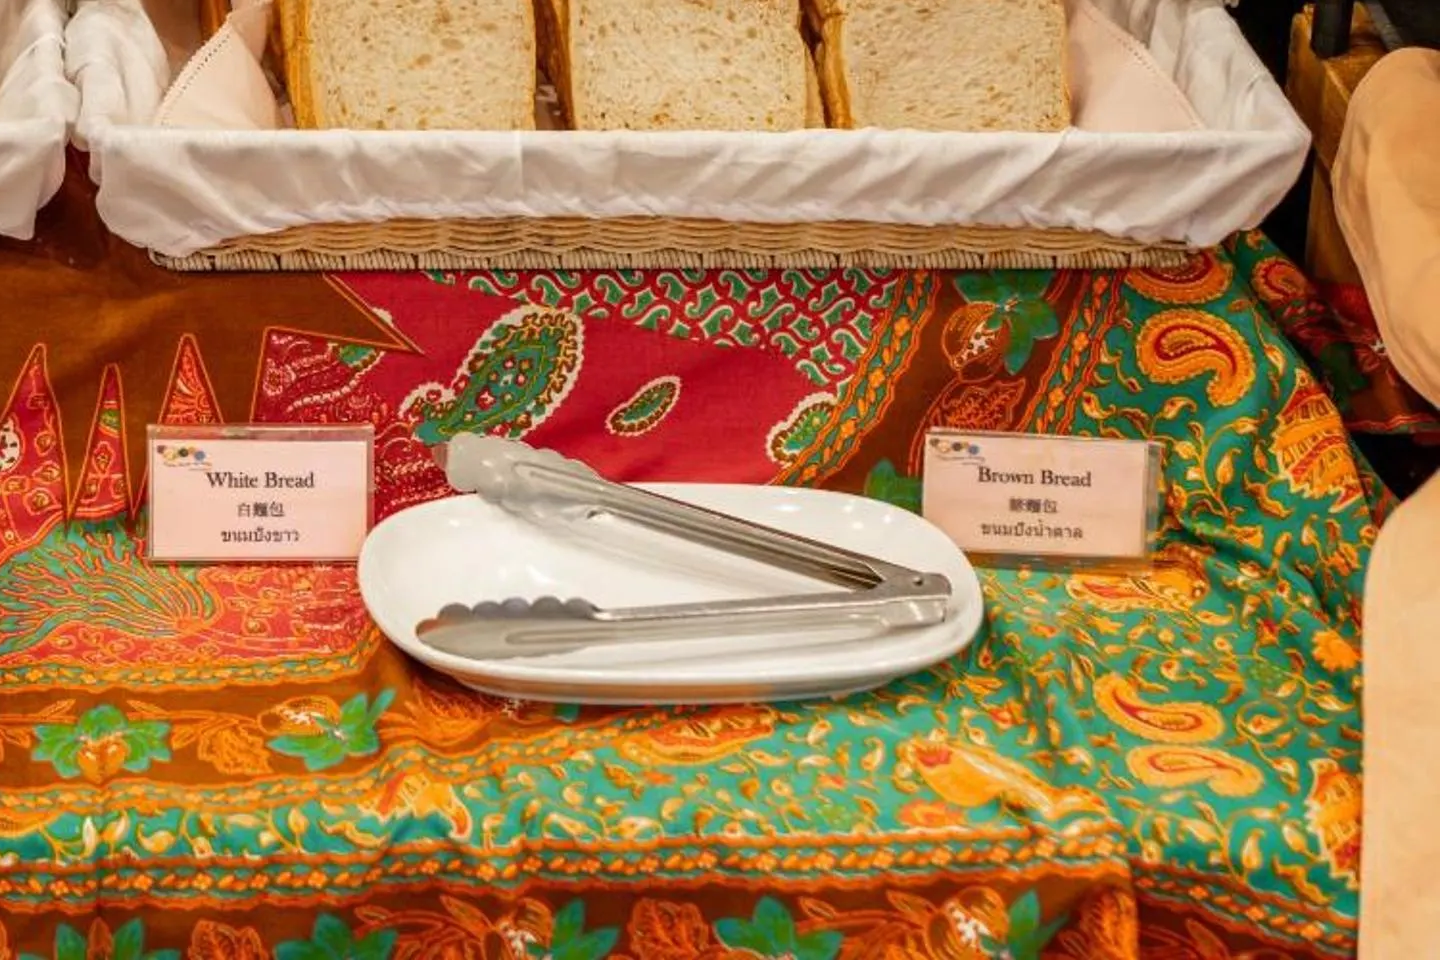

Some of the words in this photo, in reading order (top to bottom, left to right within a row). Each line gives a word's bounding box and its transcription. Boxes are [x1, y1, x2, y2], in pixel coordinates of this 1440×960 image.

[206, 471, 259, 489] White
[264, 471, 315, 489] Bread
[977, 466, 1035, 485] Brown
[1040, 469, 1092, 488] Bread
